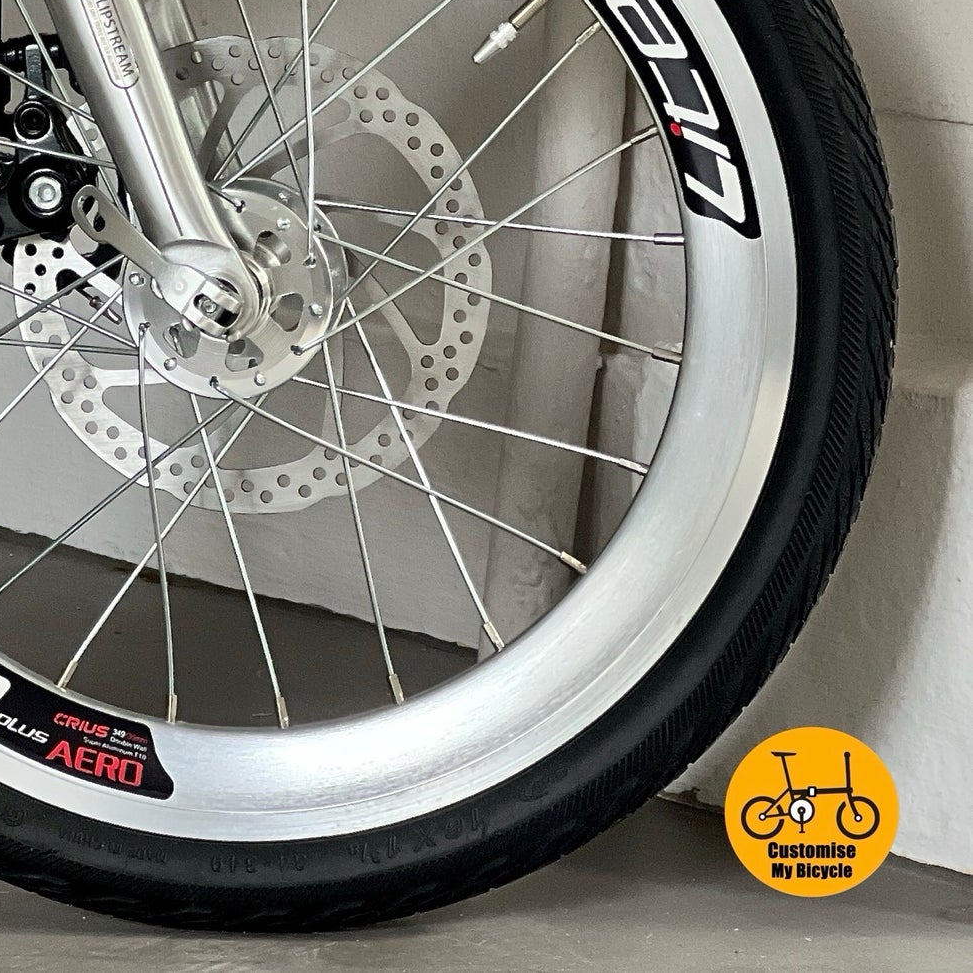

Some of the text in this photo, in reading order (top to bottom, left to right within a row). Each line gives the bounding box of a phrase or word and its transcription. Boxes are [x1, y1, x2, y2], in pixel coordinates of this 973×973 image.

[53, 712, 126, 738] CRIUS 349
[45, 740, 144, 787] AERO
